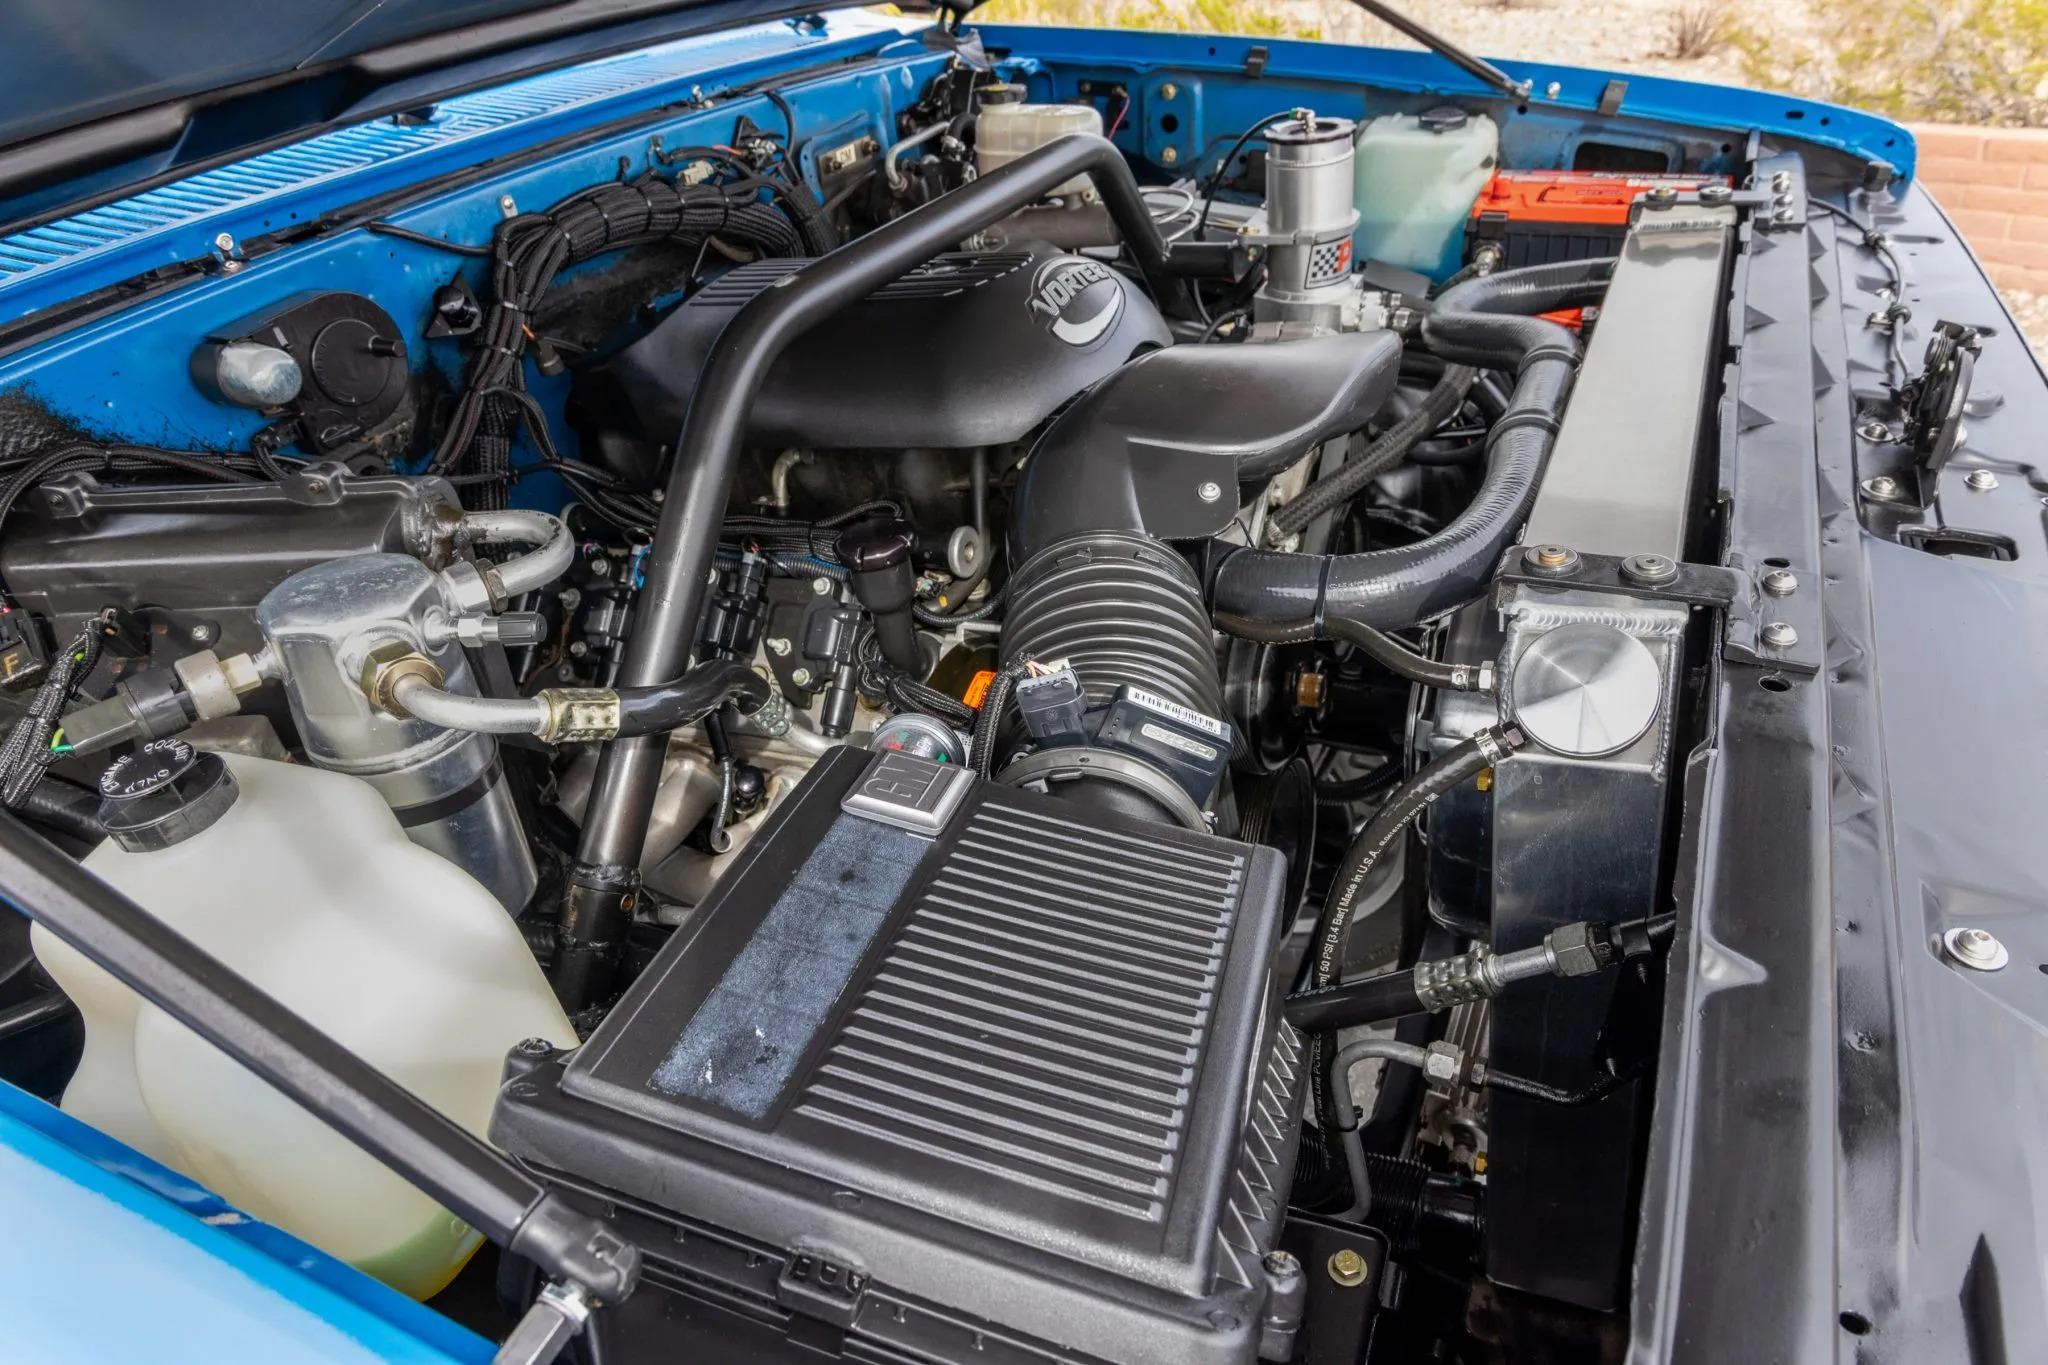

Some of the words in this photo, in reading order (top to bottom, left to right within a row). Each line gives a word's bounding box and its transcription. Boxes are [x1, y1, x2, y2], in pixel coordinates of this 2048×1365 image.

[144, 738, 189, 761] COOLANT
[101, 755, 133, 793] ENGINE
[125, 768, 170, 794] ONLY
[863, 753, 940, 799] GM
[1357, 848, 1381, 873] U.S.A.
[1350, 873, 1364, 885] in
[1339, 882, 1358, 908] Made
[1331, 907, 1349, 927] Bar]
[1327, 926, 1340, 944] [3.4
[1321, 943, 1334, 960] PSI
[1319, 960, 1331, 973] 50
